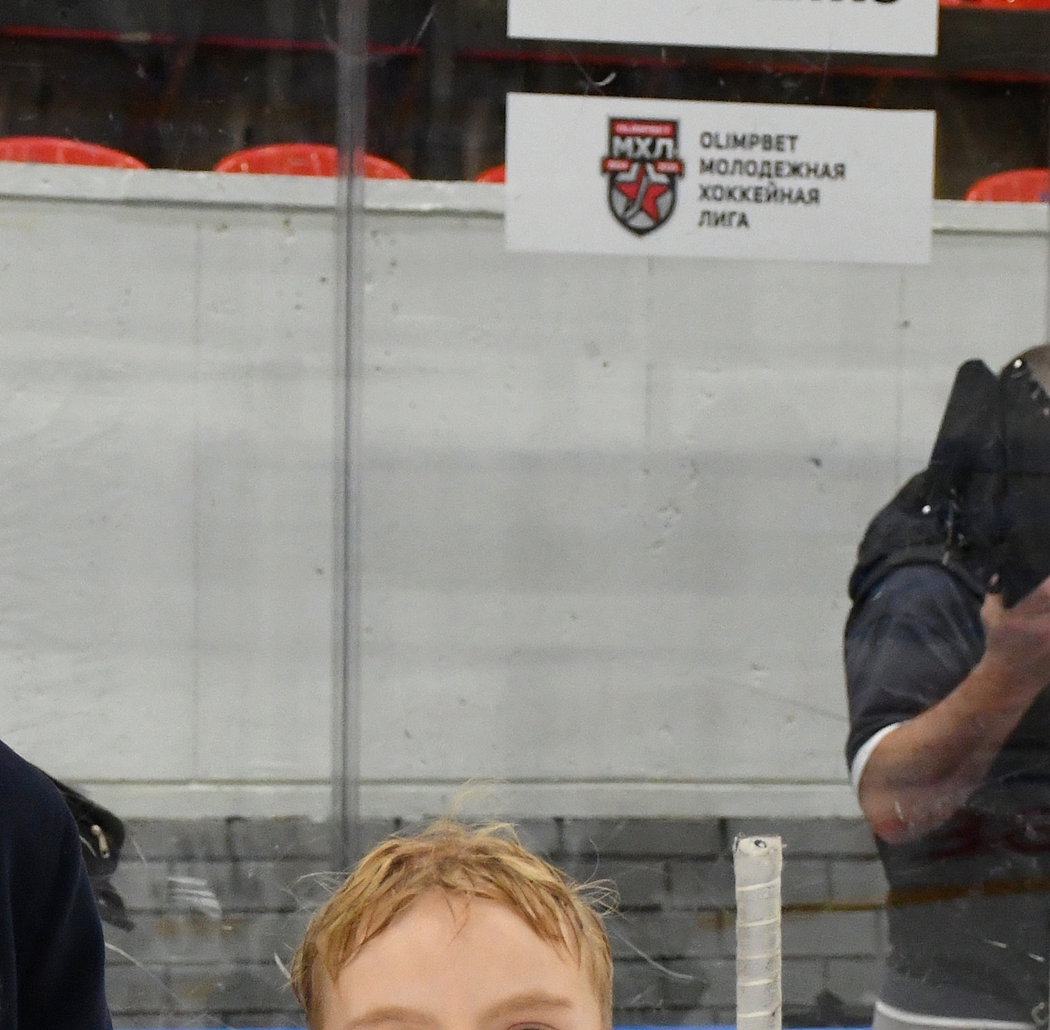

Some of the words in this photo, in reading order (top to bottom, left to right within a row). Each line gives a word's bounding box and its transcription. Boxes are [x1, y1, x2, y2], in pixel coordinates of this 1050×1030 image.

[612, 136, 674, 159] МХЛ
[700, 132, 798, 151] OLIMPBET
[700, 159, 846, 179] МОЛОДЕЖНАЯ
[699, 181, 821, 204] ХОККЕЙНАЯ
[698, 211, 749, 228] ЛИГА
